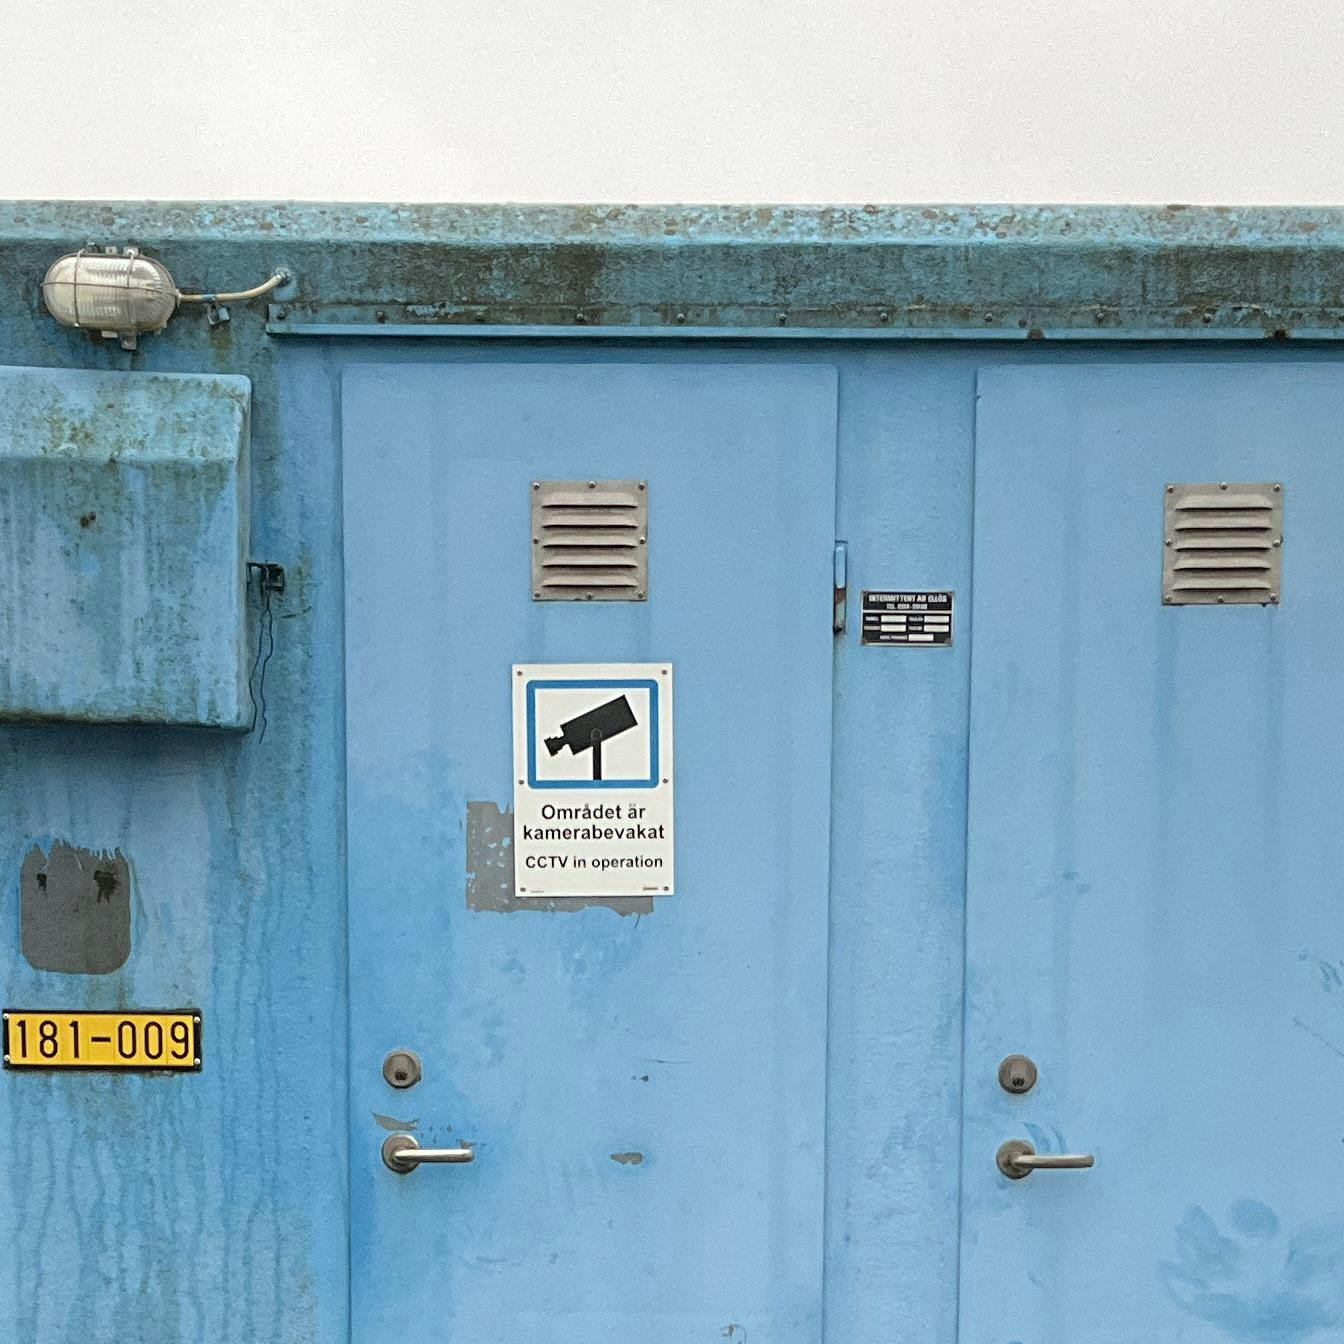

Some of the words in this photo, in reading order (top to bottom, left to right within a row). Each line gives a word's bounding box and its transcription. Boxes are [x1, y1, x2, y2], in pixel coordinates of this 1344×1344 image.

[541, 803, 622, 820] Området
[627, 803, 646, 820] är
[523, 824, 665, 841] kamerabevakat
[525, 856, 568, 869] CCTV
[573, 856, 587, 868] in
[591, 856, 663, 871] operation
[17, 1020, 189, 1060] 181-009
